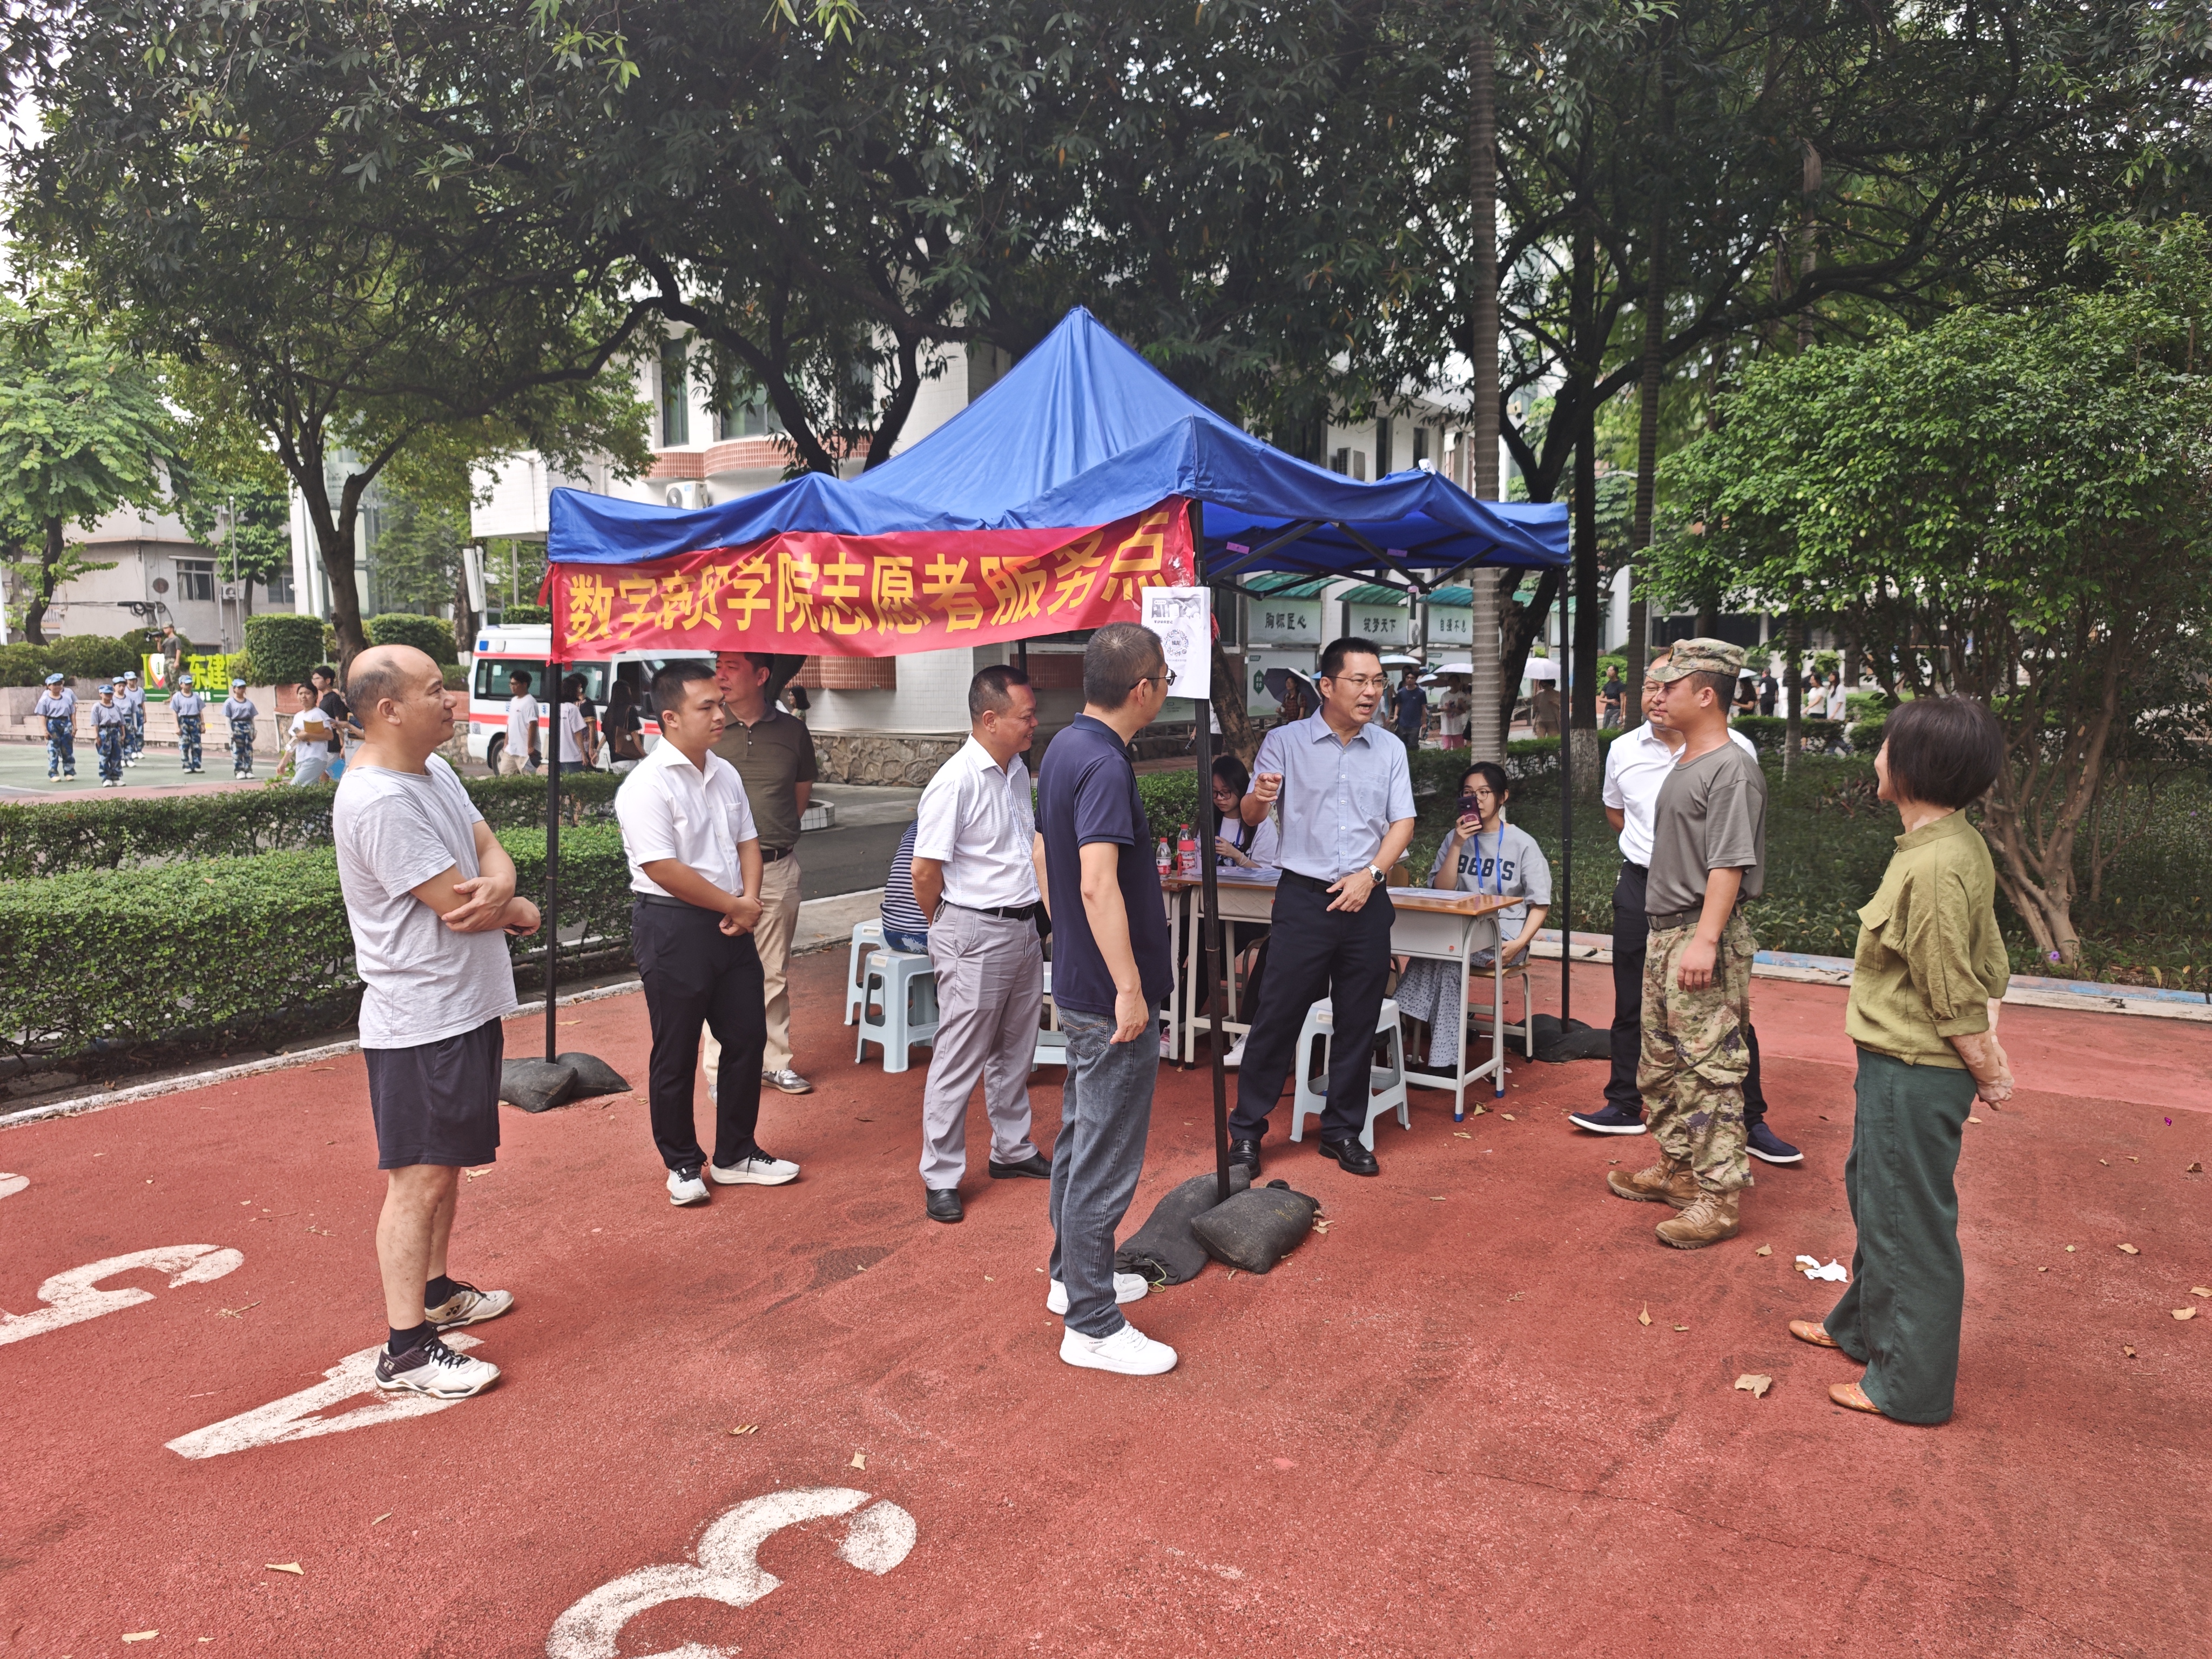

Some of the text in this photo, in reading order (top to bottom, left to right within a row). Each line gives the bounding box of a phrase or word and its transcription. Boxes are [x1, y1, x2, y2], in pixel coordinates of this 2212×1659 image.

[567, 511, 1169, 645] 数字商贸学院志愿者服务点
